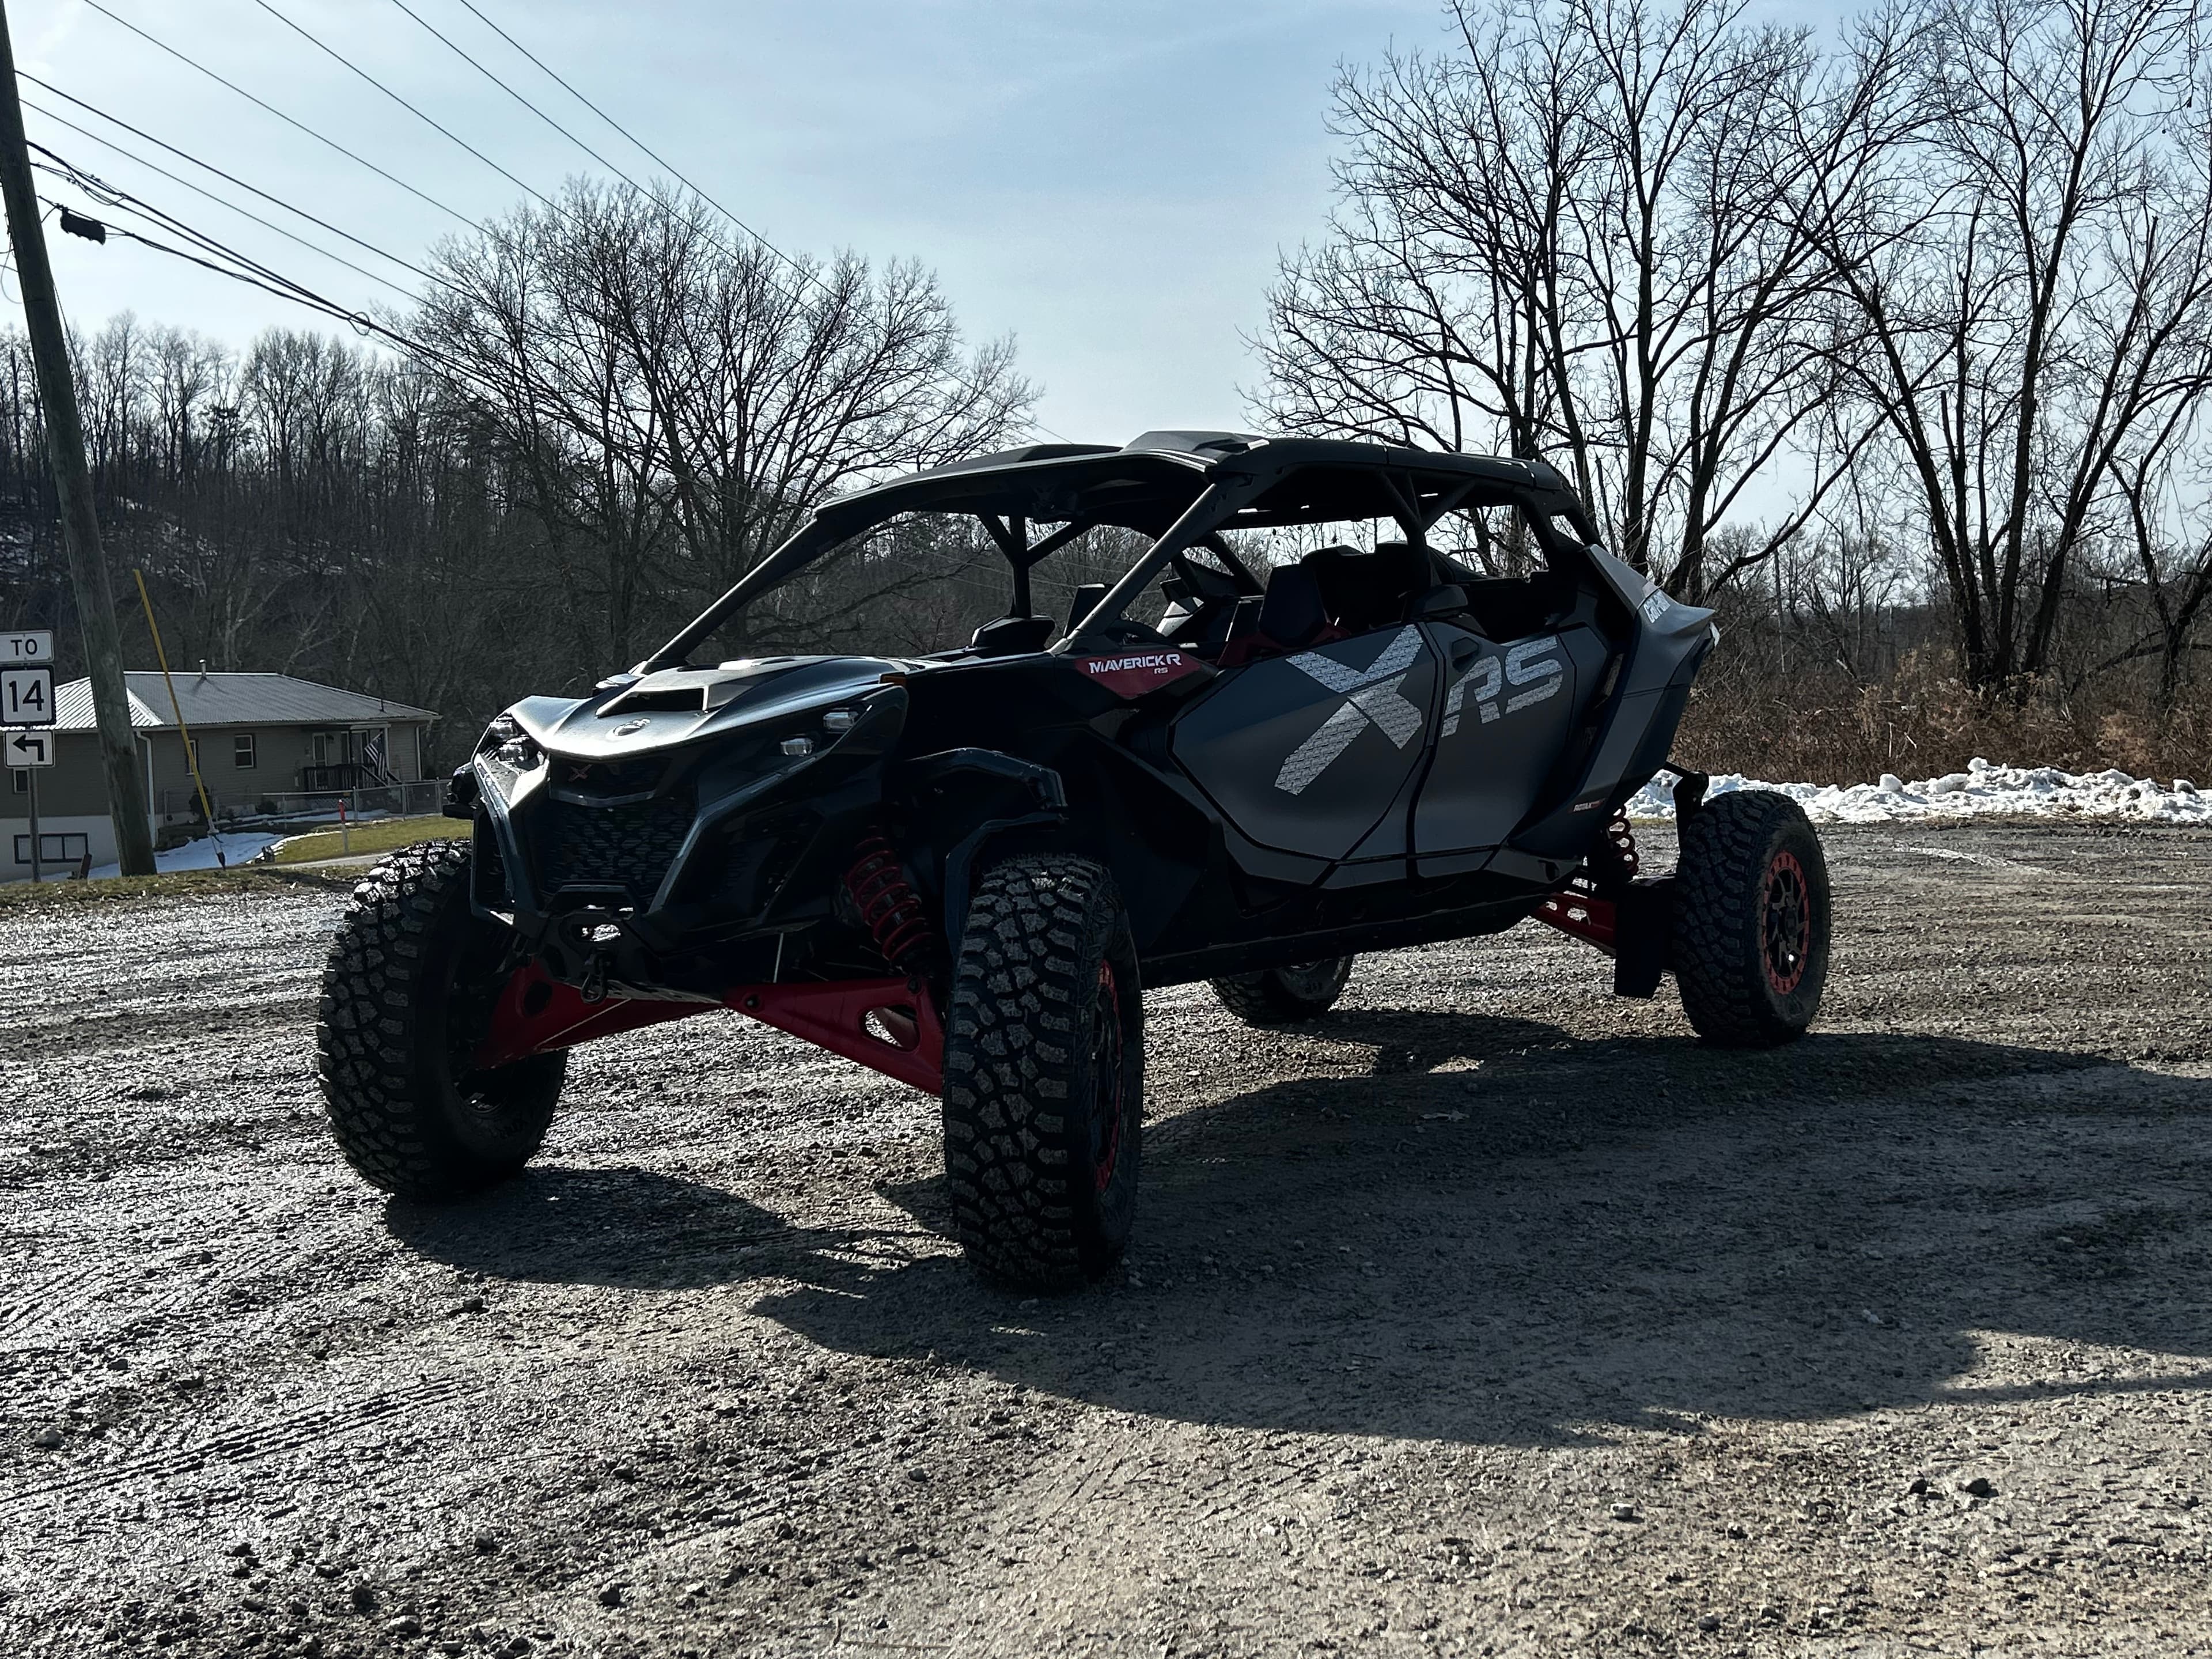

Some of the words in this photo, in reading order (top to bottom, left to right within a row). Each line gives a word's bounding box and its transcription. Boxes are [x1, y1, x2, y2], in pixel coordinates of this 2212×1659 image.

[10, 638, 37, 656] TO
[1153, 666, 1169, 675] RS
[9, 680, 44, 712] 14
